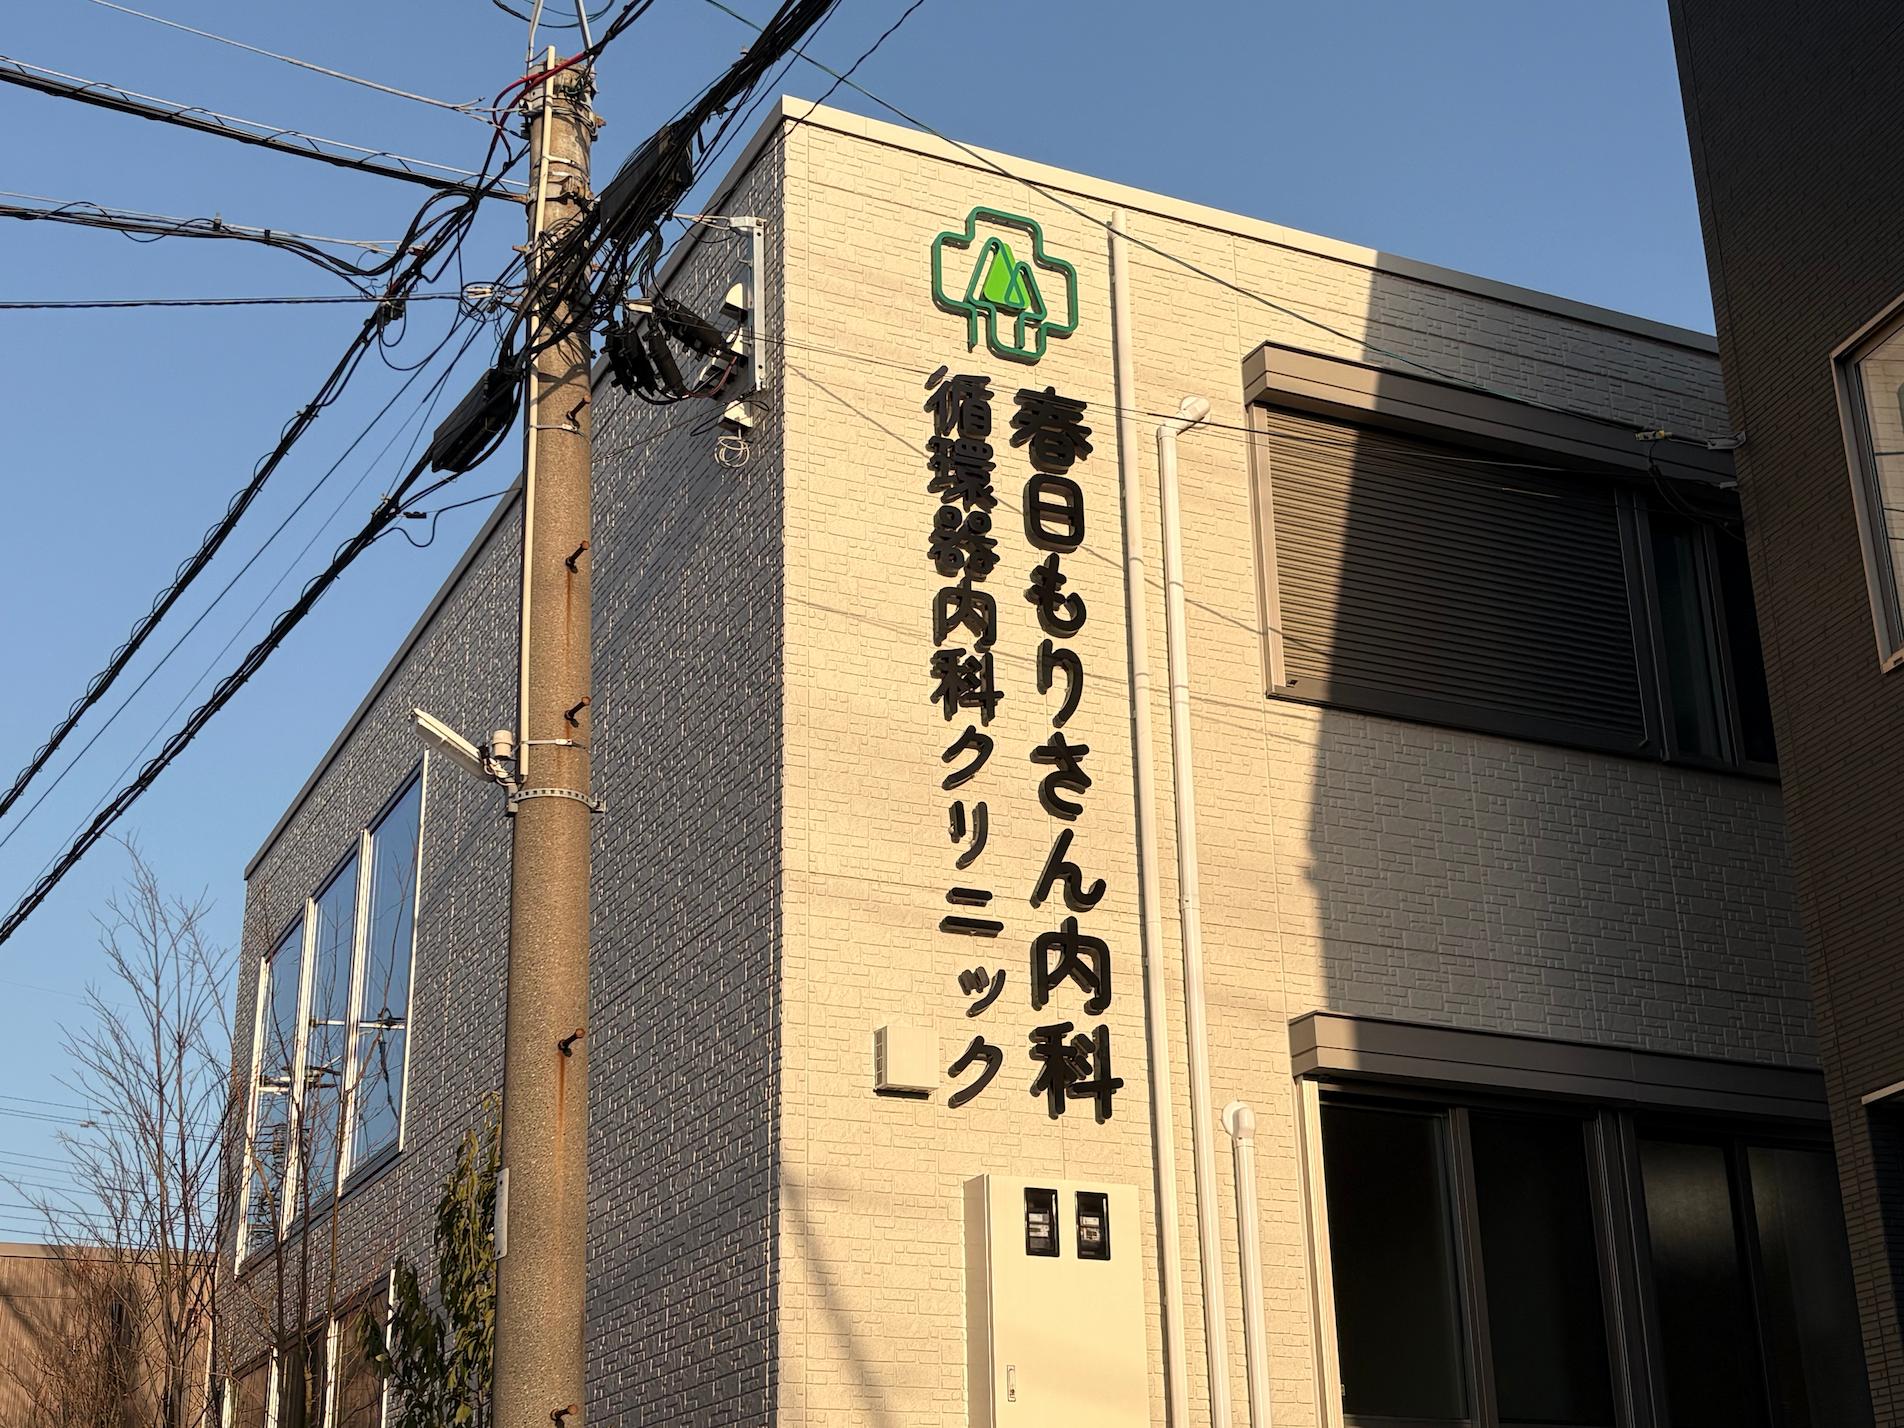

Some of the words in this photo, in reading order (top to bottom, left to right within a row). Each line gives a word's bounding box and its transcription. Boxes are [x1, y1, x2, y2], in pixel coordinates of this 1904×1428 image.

[924, 365, 1006, 1108] 循環器内科クリニック
[1010, 386, 1123, 1124] 春日もりさん内科
